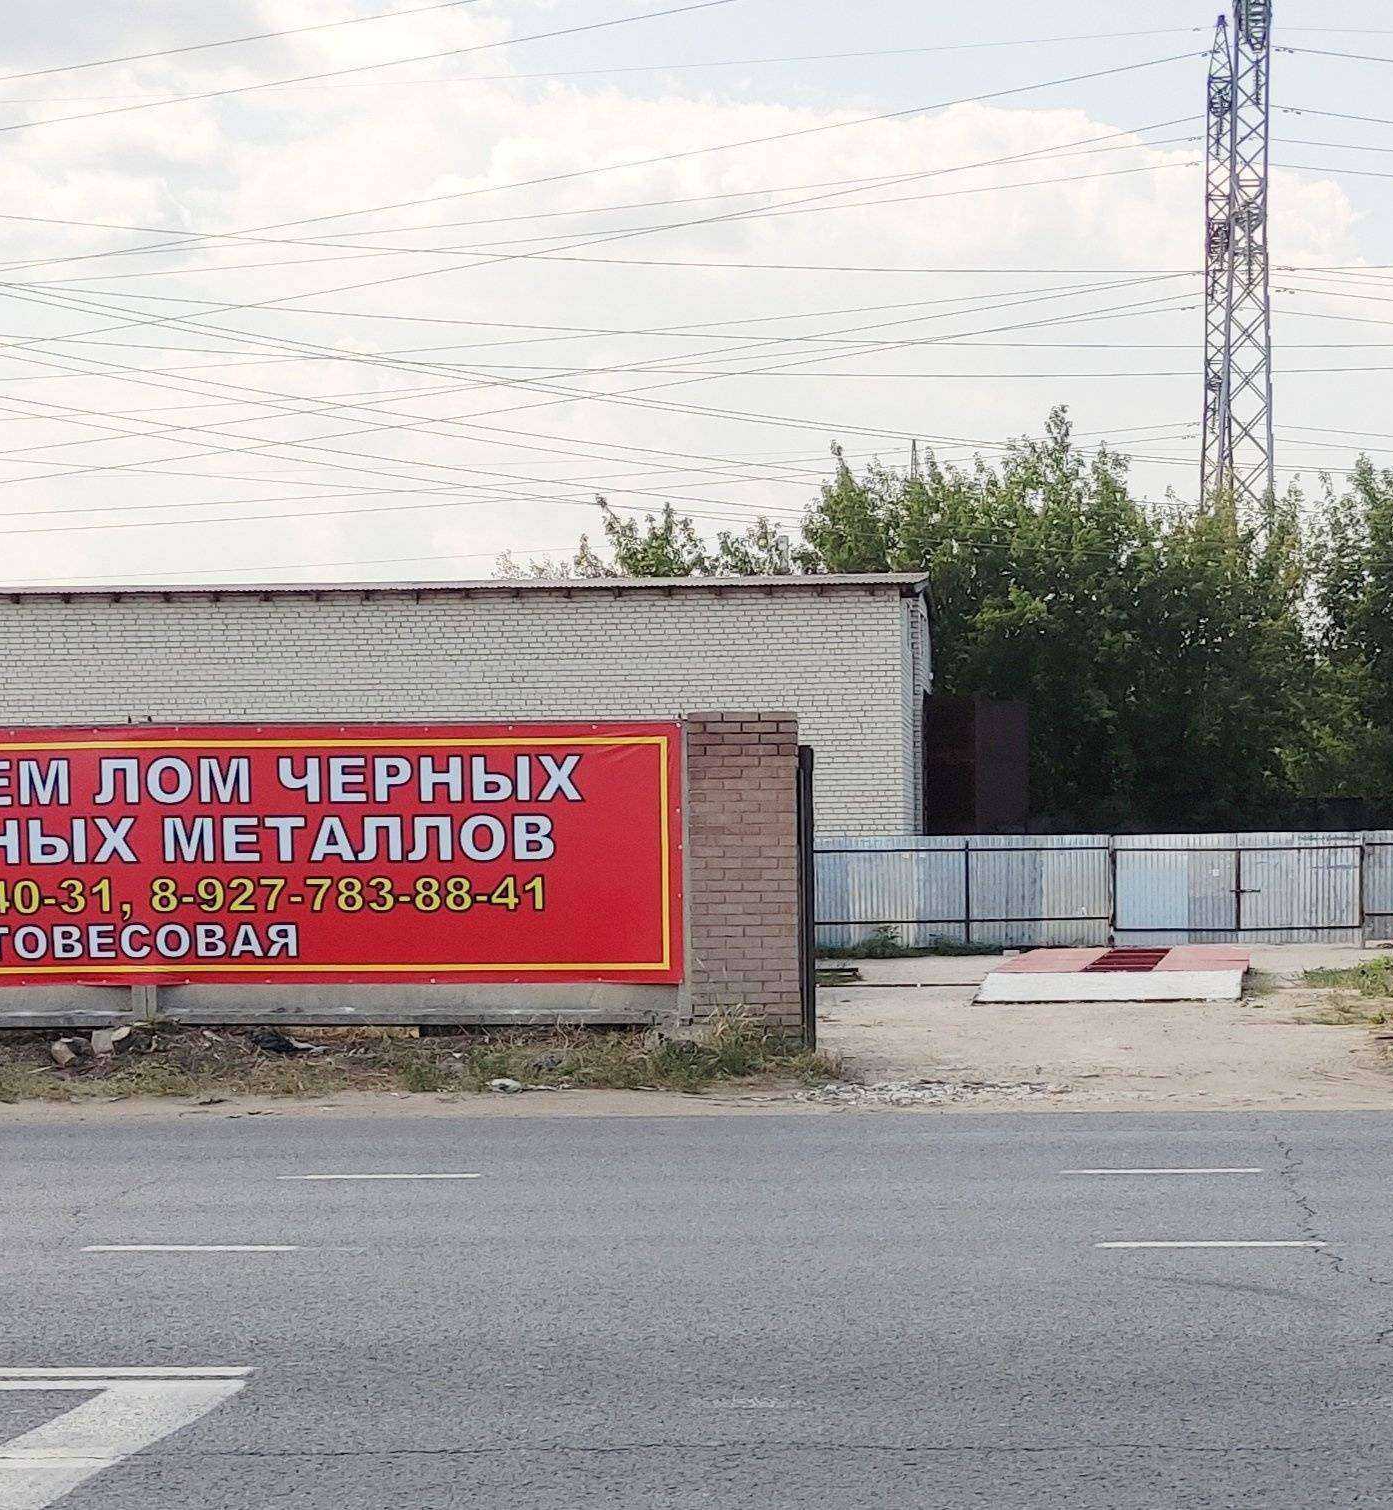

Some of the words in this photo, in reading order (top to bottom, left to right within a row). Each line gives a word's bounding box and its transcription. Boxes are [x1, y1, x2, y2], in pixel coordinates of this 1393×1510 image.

[92, 757, 255, 806] ЛОМ
[278, 754, 585, 804] ЧЕРНЫХ
[162, 813, 557, 865] МЕТАЛЛОВ
[149, 875, 547, 915] 8-927-783-88-41
